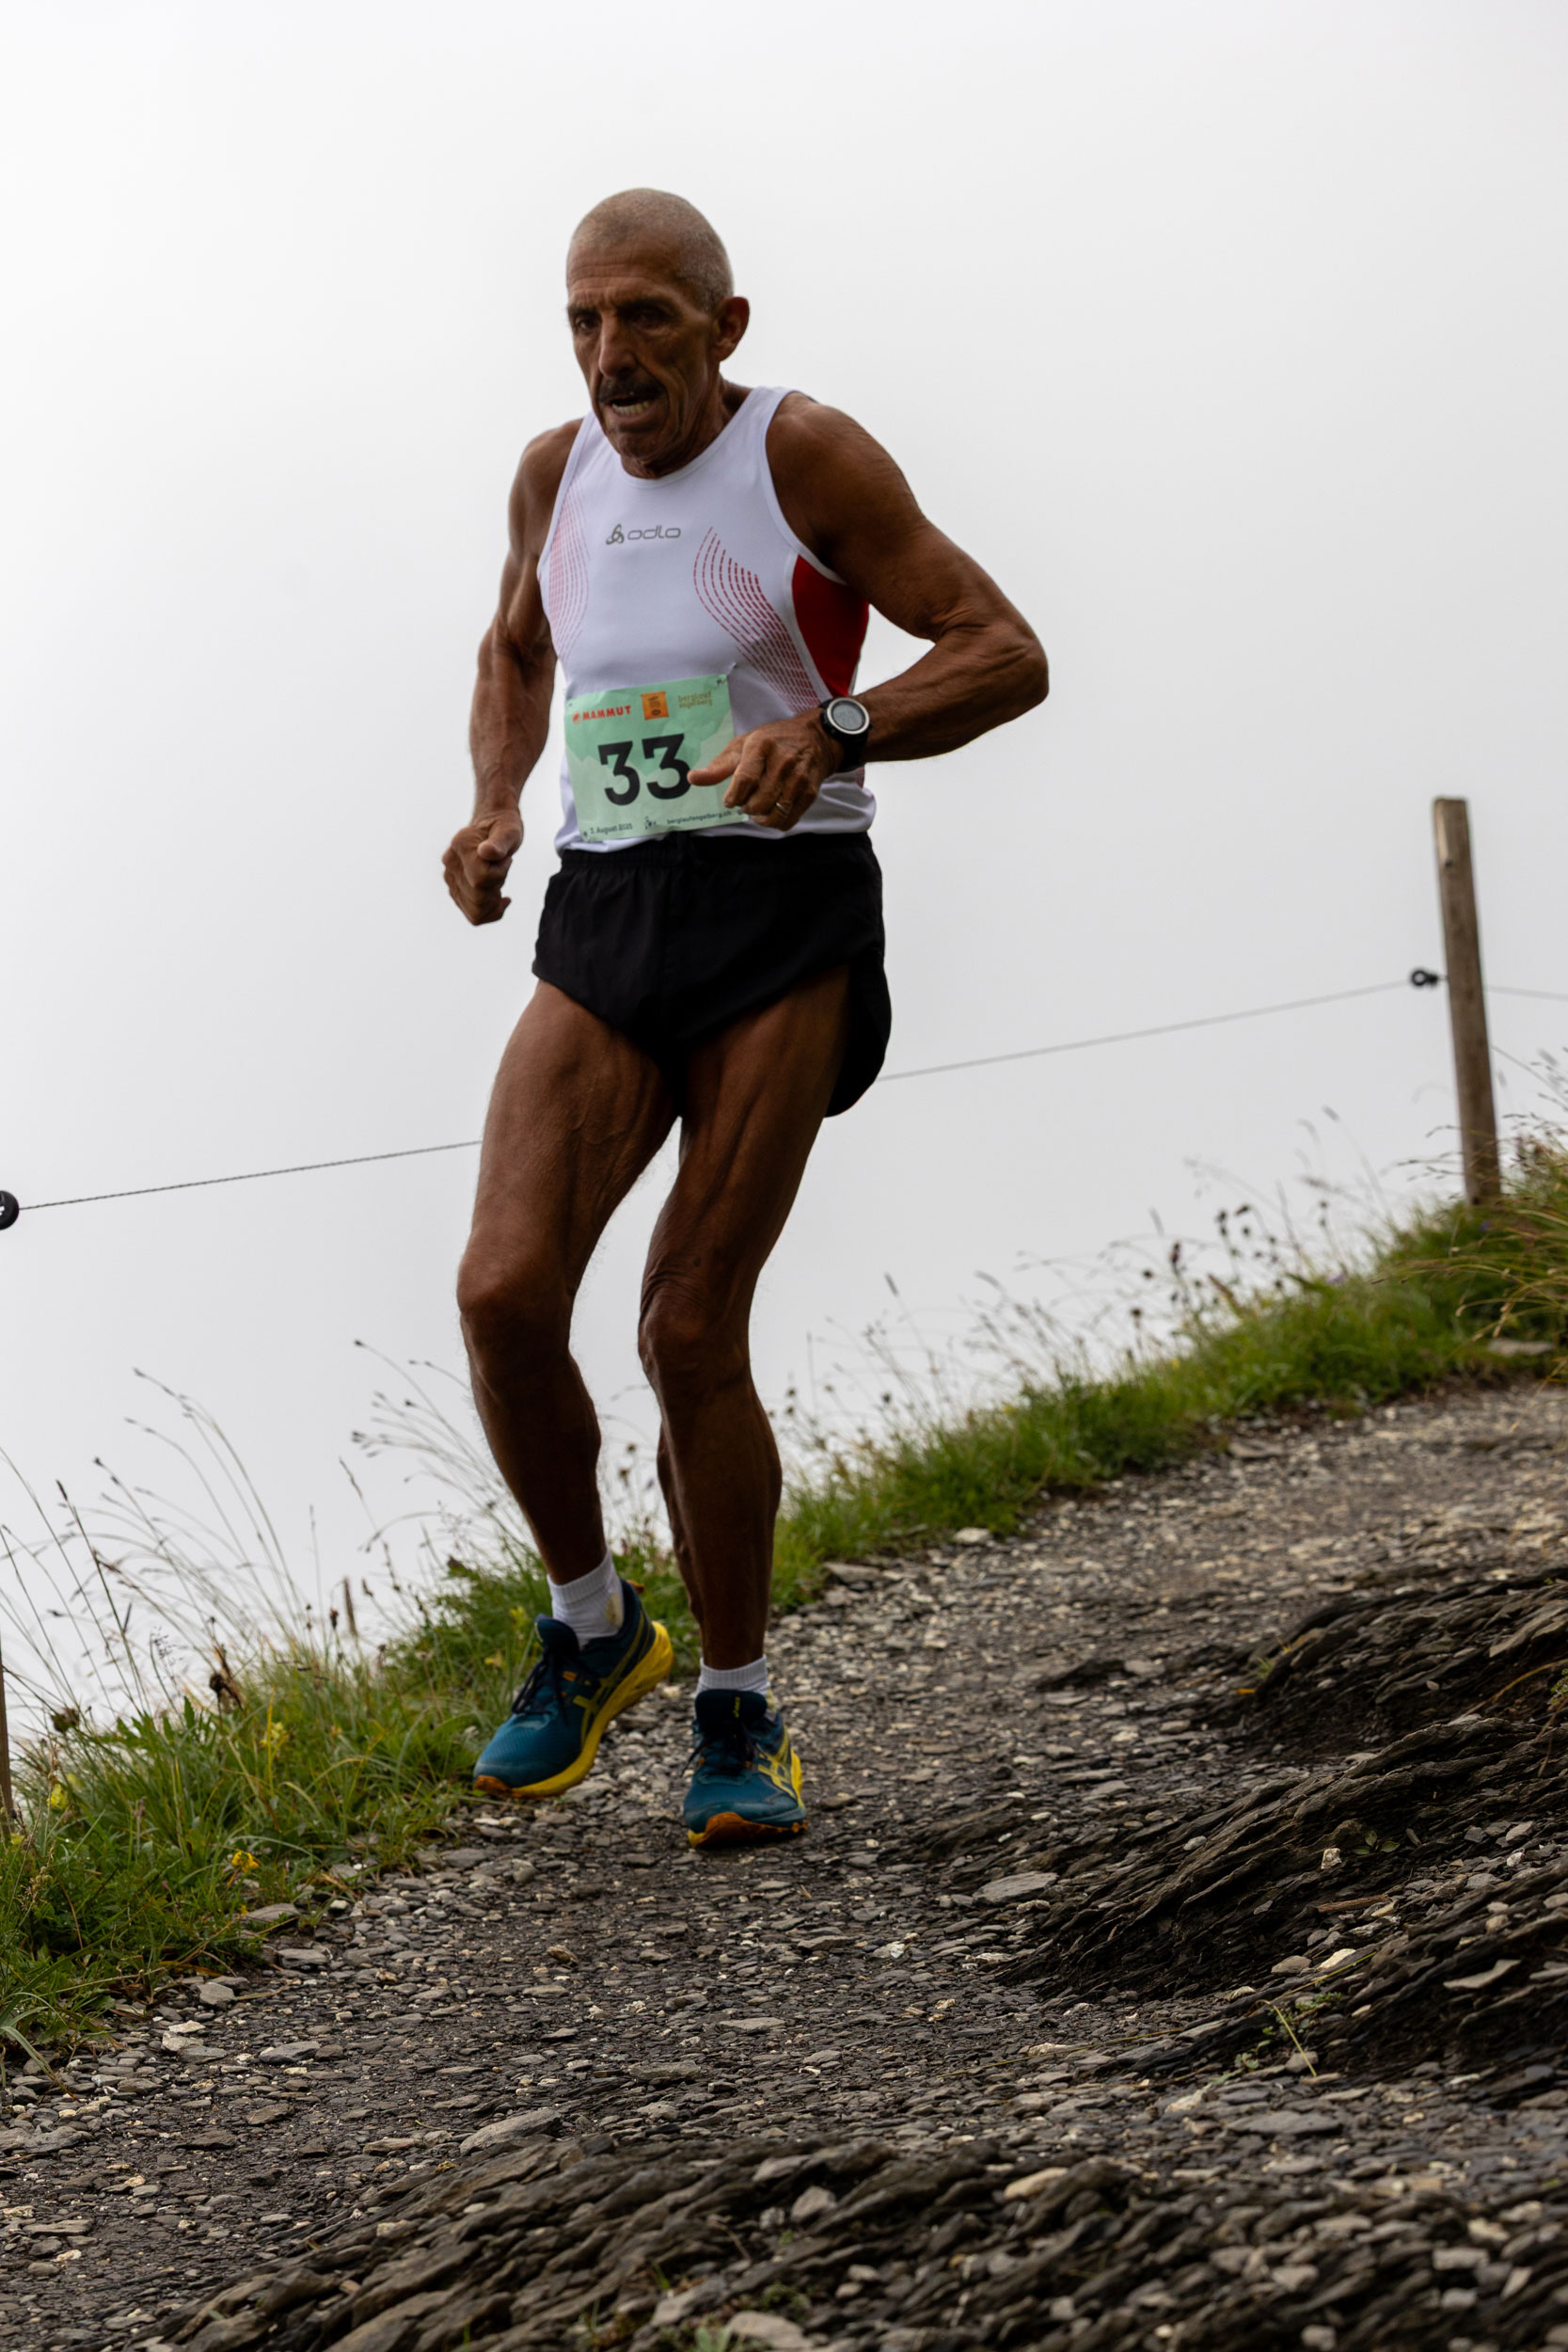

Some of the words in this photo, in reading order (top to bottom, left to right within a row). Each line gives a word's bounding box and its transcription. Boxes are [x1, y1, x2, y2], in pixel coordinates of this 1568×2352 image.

[627, 524, 682, 541] odlo
[581, 705, 632, 721] MAMMUT
[597, 733, 691, 805] 33
[596, 825, 617, 835] August
[618, 822, 633, 832] 2025
